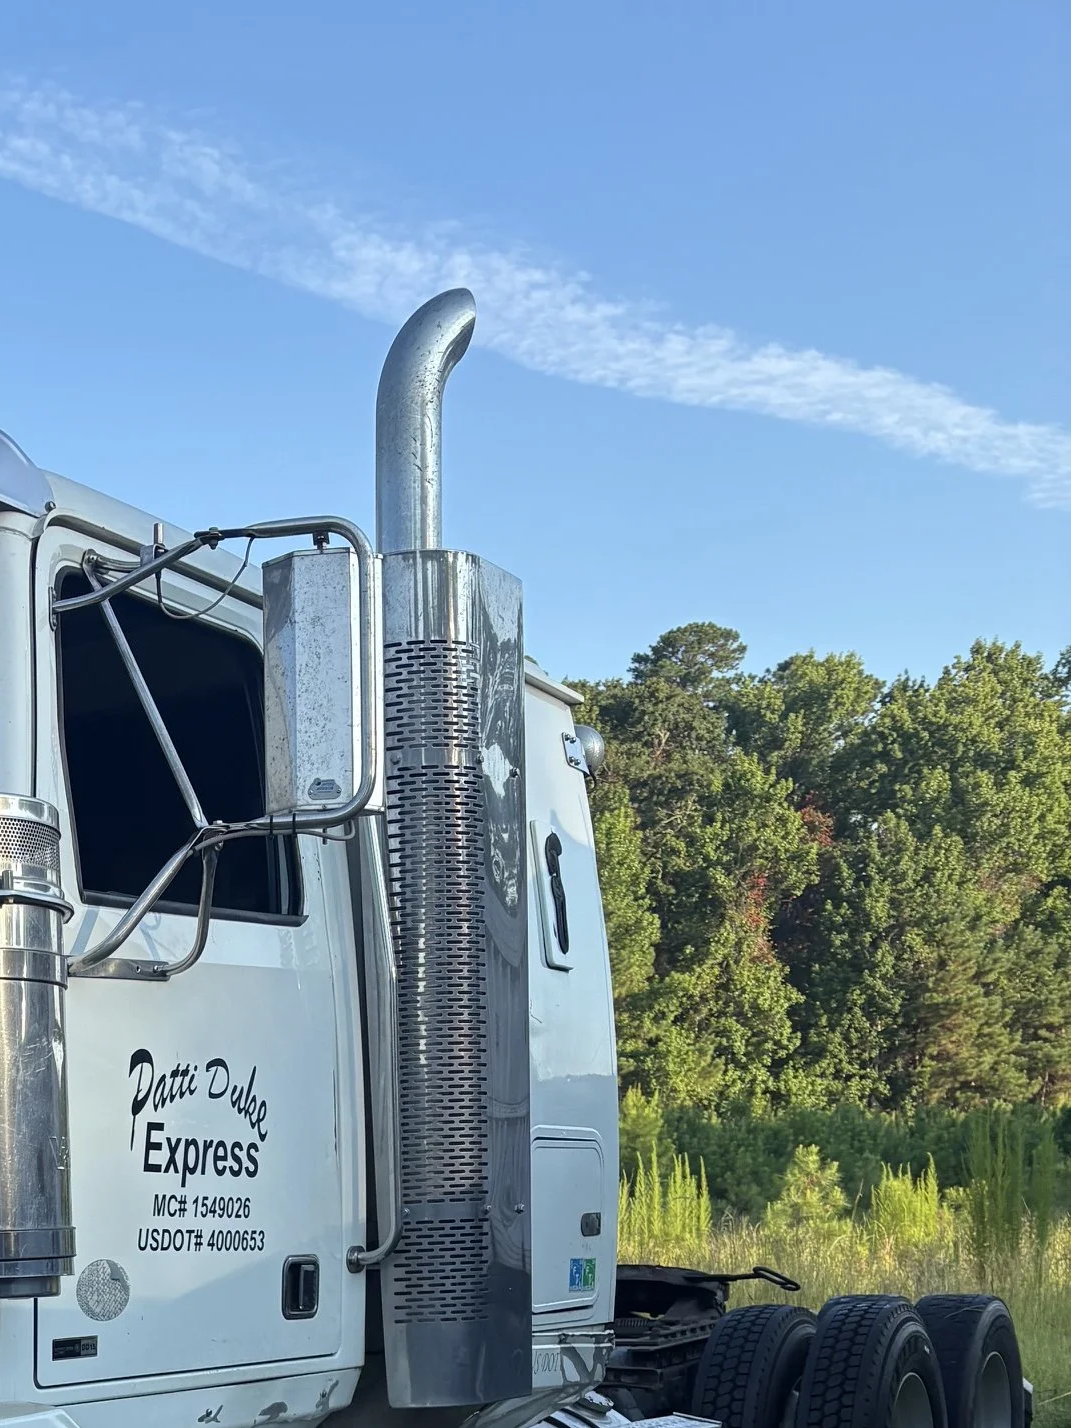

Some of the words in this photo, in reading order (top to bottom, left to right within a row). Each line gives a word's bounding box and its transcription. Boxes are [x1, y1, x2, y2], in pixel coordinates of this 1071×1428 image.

[128, 1048, 198, 1151] Patti
[205, 1058, 268, 1142] Duke
[143, 1122, 260, 1188] Express
[152, 1194, 188, 1218] MC#
[192, 1196, 251, 1219] 1549026
[137, 1228, 204, 1252] USDOT#
[207, 1229, 265, 1252] 4000653
